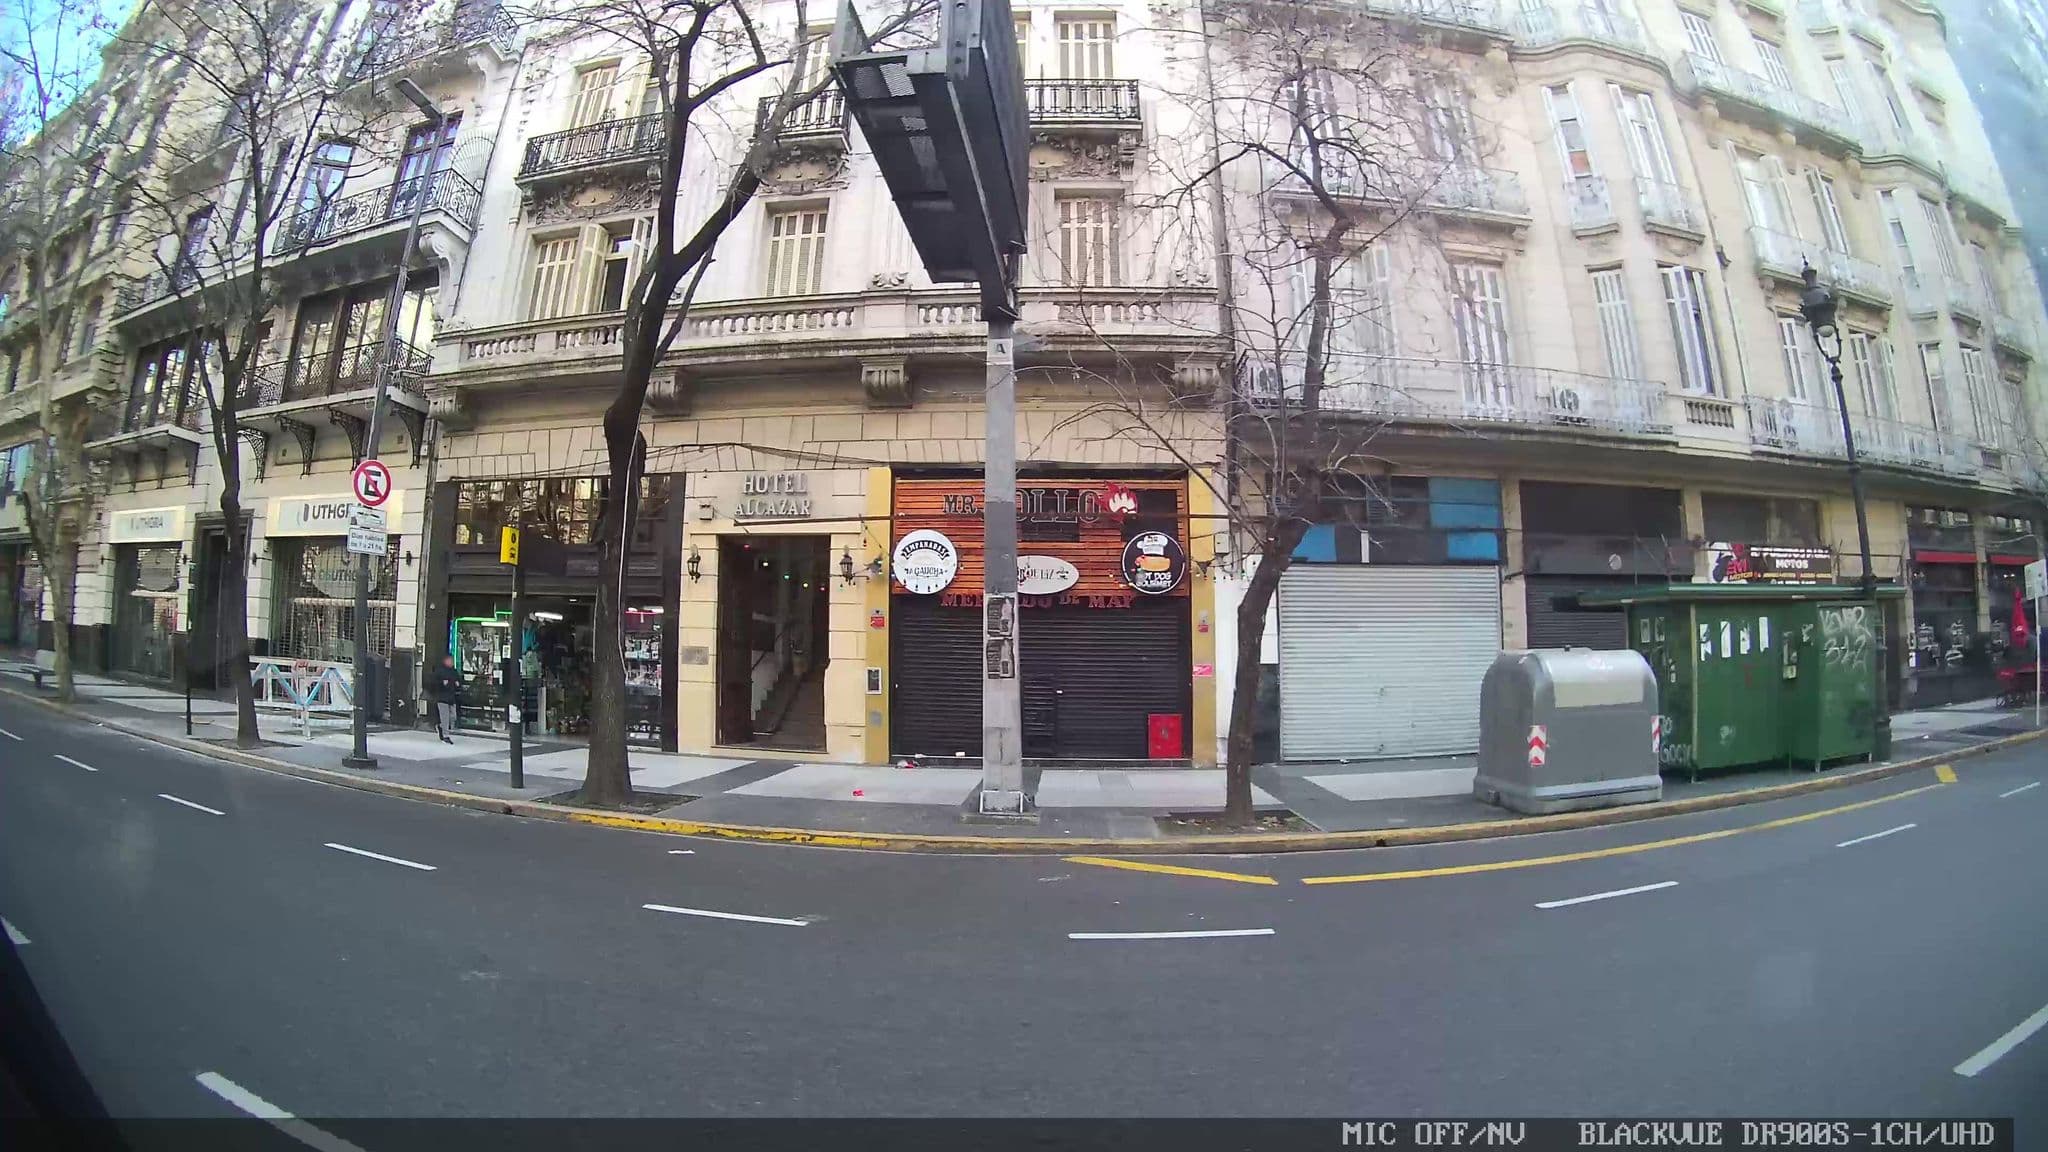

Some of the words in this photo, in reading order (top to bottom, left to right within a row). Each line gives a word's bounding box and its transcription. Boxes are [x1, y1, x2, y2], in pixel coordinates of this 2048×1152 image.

[743, 473, 808, 494] HOTEL
[734, 499, 811, 517] ALCAZAR
[980, 489, 1101, 523] OLLO
[905, 541, 947, 556] EMPANADAS
[1154, 572, 1171, 580] DOG
